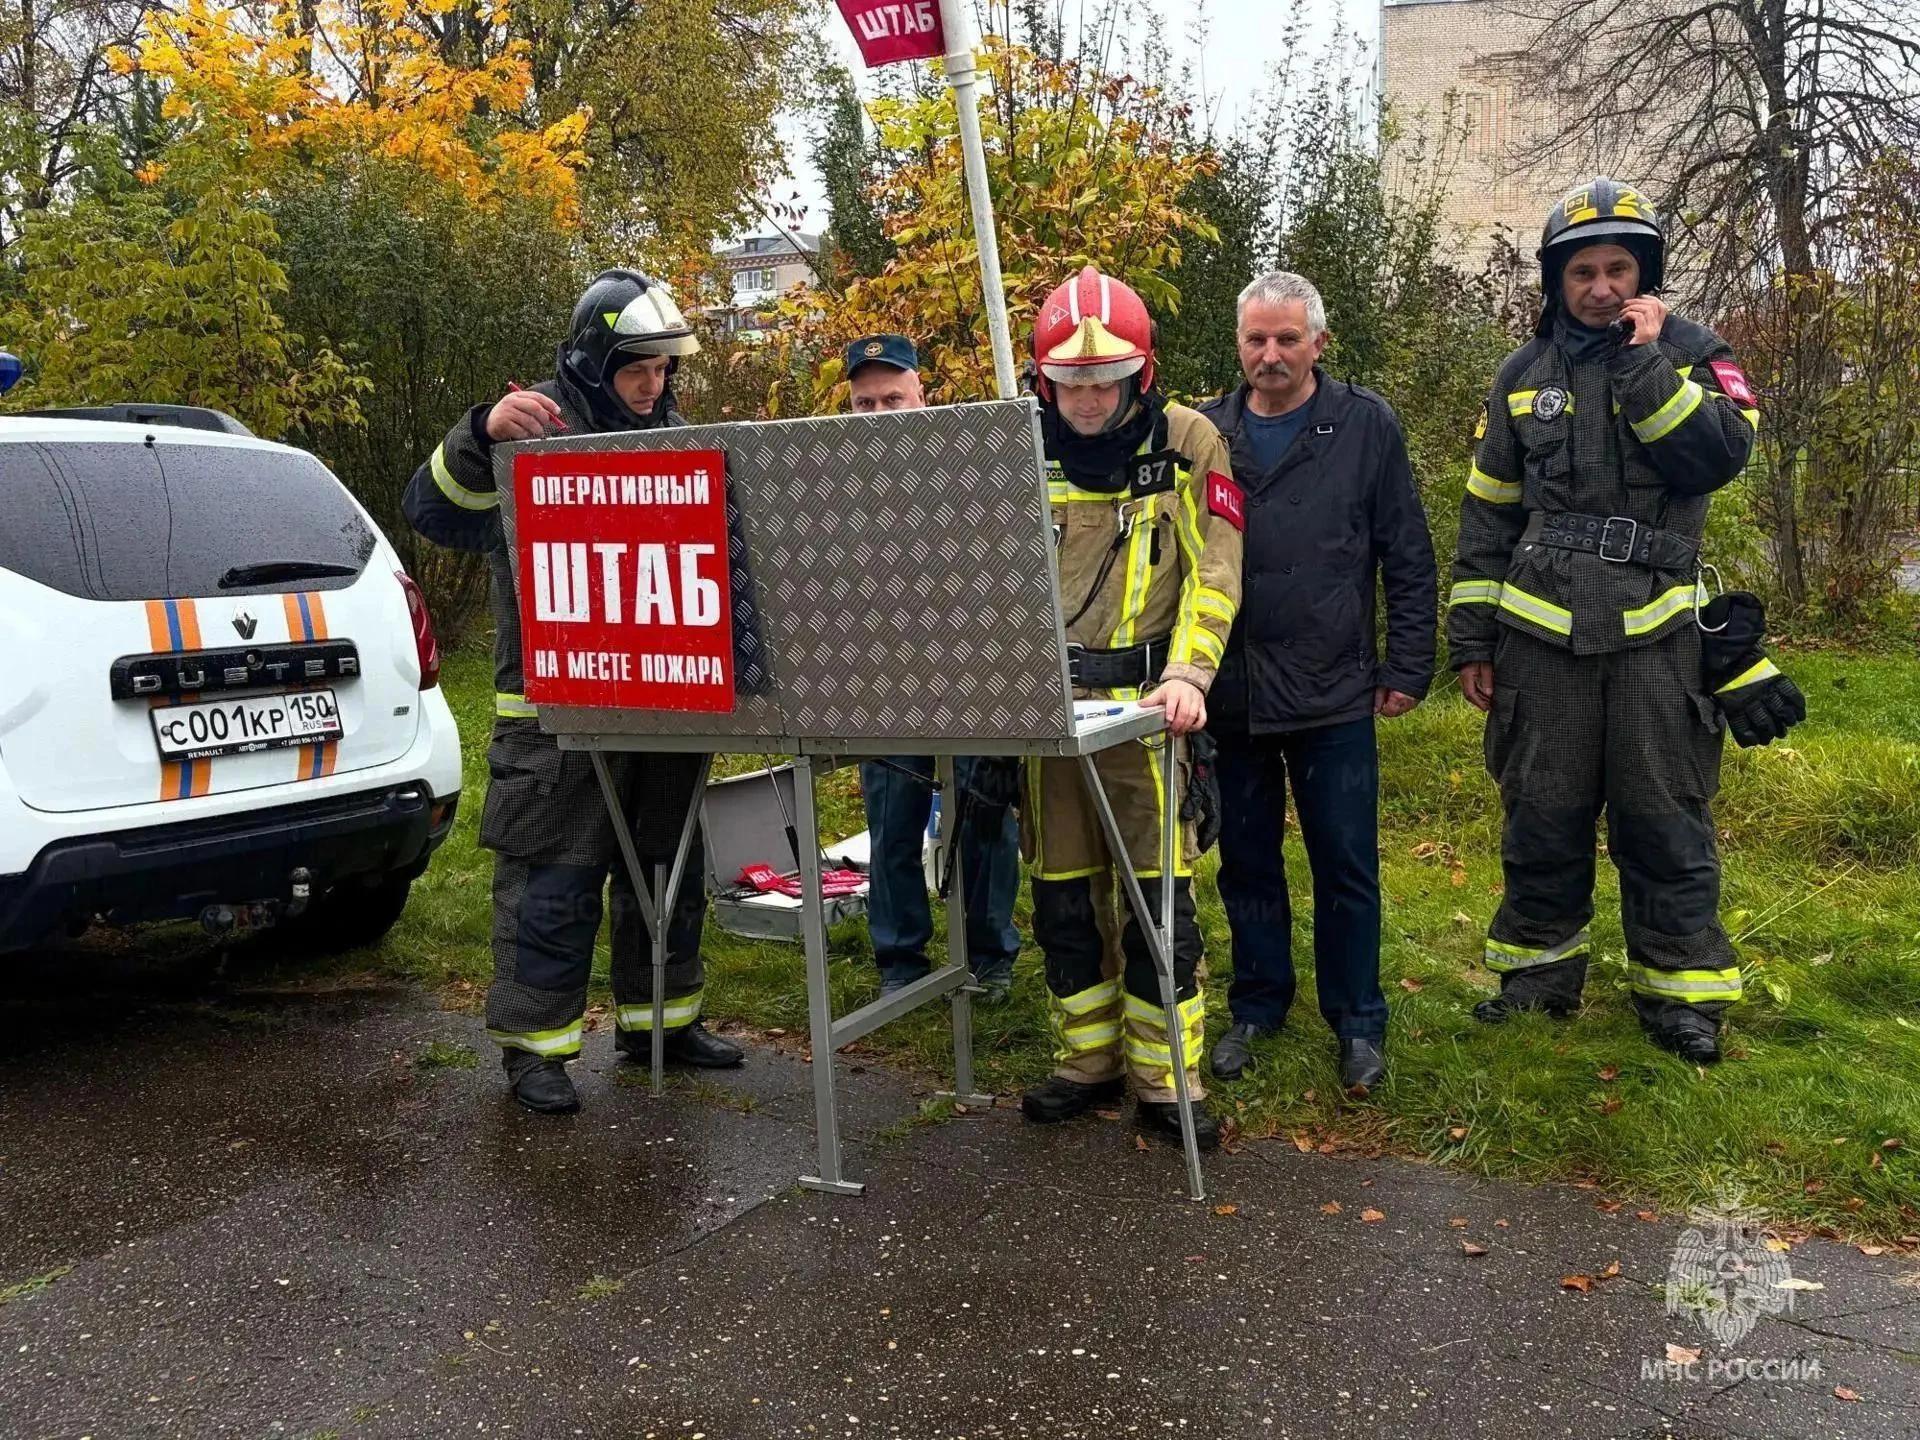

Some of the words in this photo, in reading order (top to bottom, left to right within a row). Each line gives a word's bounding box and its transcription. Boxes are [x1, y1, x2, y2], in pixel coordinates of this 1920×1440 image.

[855, 1, 935, 41] ШТАБ
[531, 469, 710, 506] ОПЕРАТИВНЫЙ
[1137, 459, 1168, 486] 87
[532, 541, 721, 627] ШТАБ
[132, 656, 359, 694] DUSTER
[535, 650, 559, 679] НА
[567, 651, 632, 682] МЕСТЕ
[641, 654, 724, 686] ПОЖАРА
[290, 695, 330, 722] 150
[302, 720, 322, 731] RUS
[187, 748, 224, 760] RENAULT
